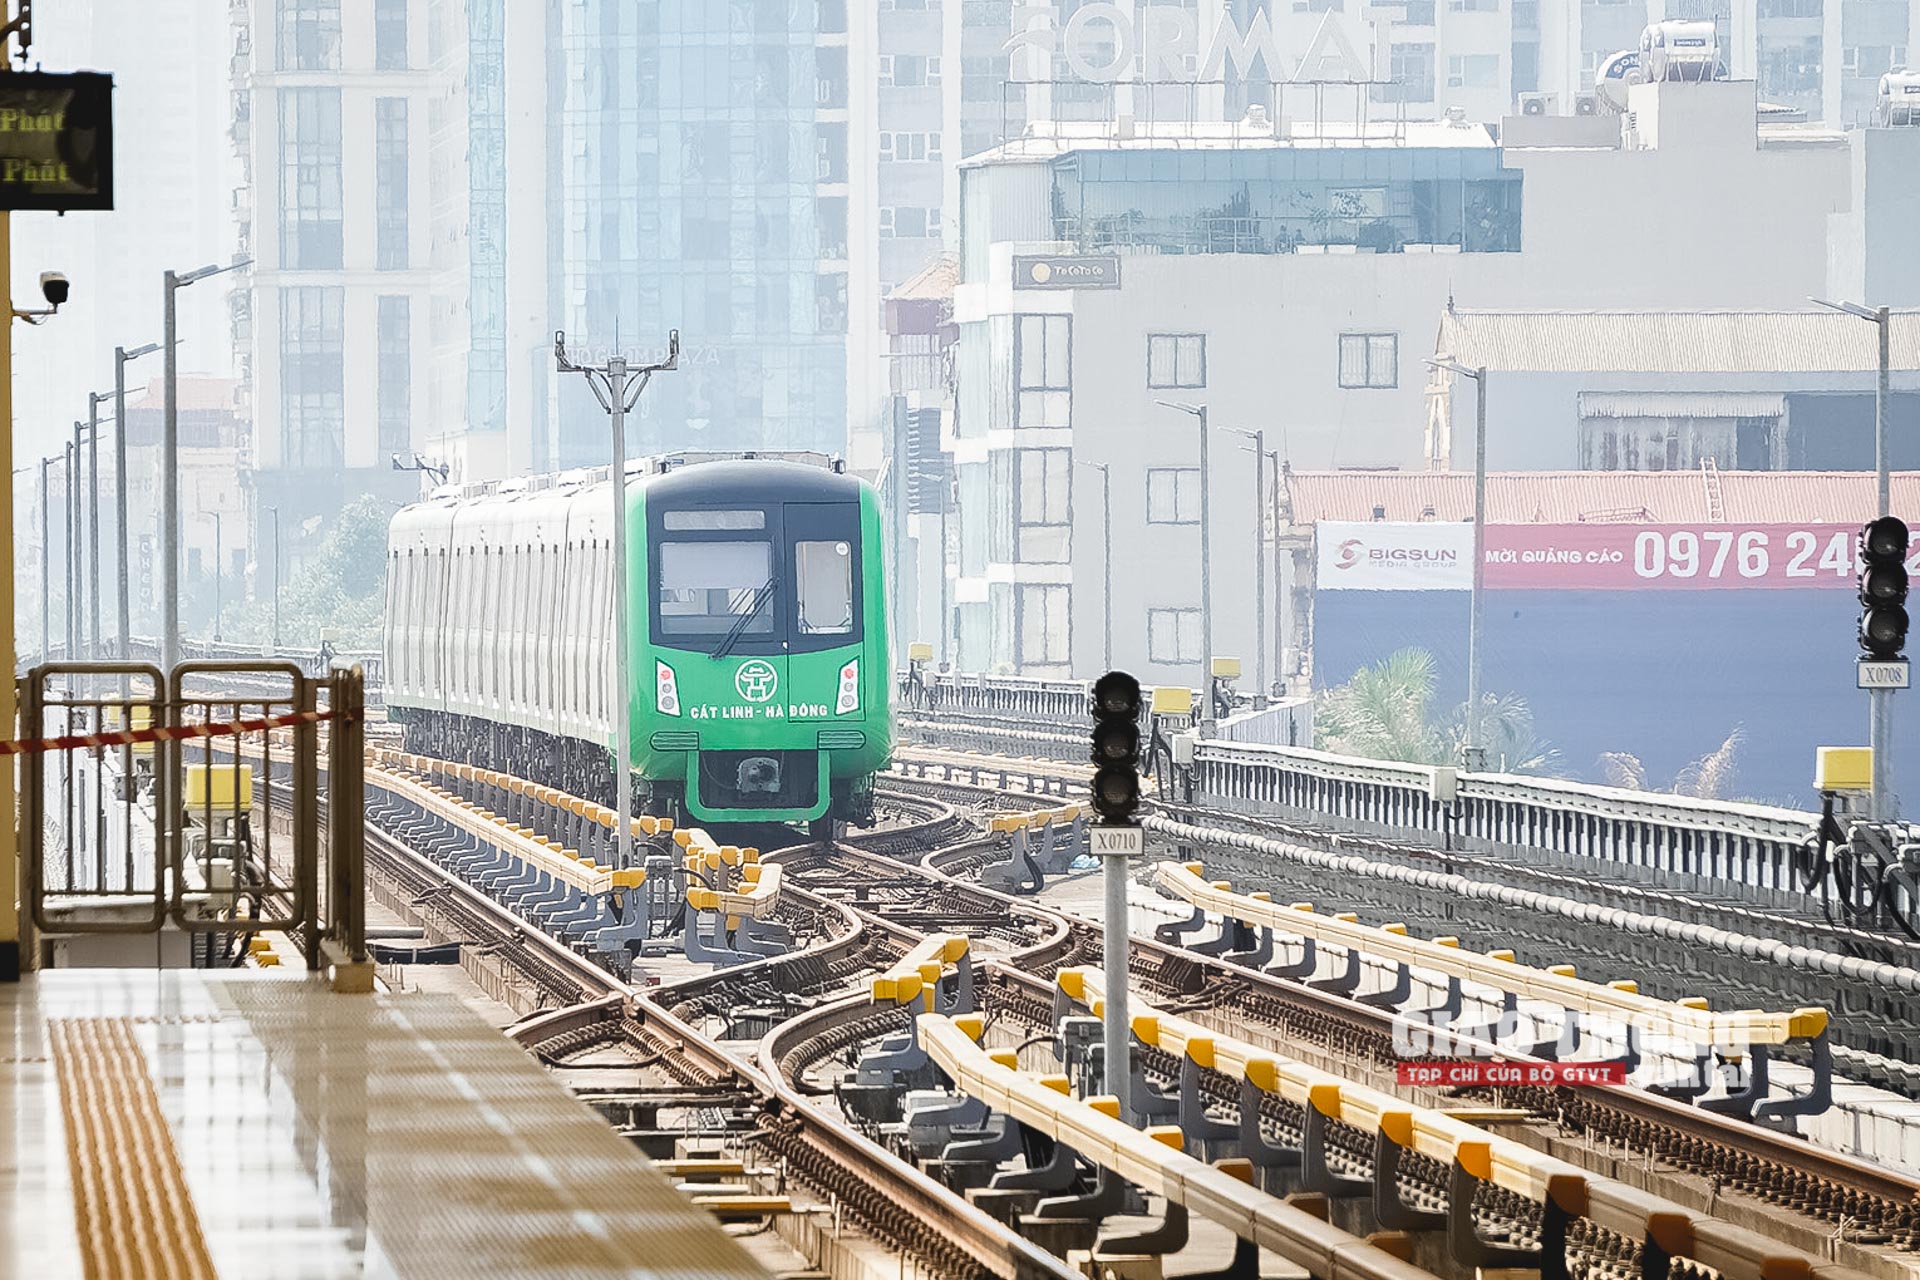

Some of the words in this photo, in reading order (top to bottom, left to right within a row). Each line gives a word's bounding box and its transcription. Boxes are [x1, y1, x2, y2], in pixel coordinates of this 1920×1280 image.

[1369, 549, 1457, 562] BIGSUN
[1521, 546, 1582, 563] QUẢNG
[1585, 548, 1623, 563] CÁO
[1634, 531, 1769, 578] 0976
[1865, 667, 1902, 683] X0708
[690, 704, 717, 719] CÁT
[722, 705, 753, 719] LINH
[765, 703, 784, 718] HÀ
[789, 702, 828, 717] ĐÔNG
[1097, 832, 1136, 850] X0710
